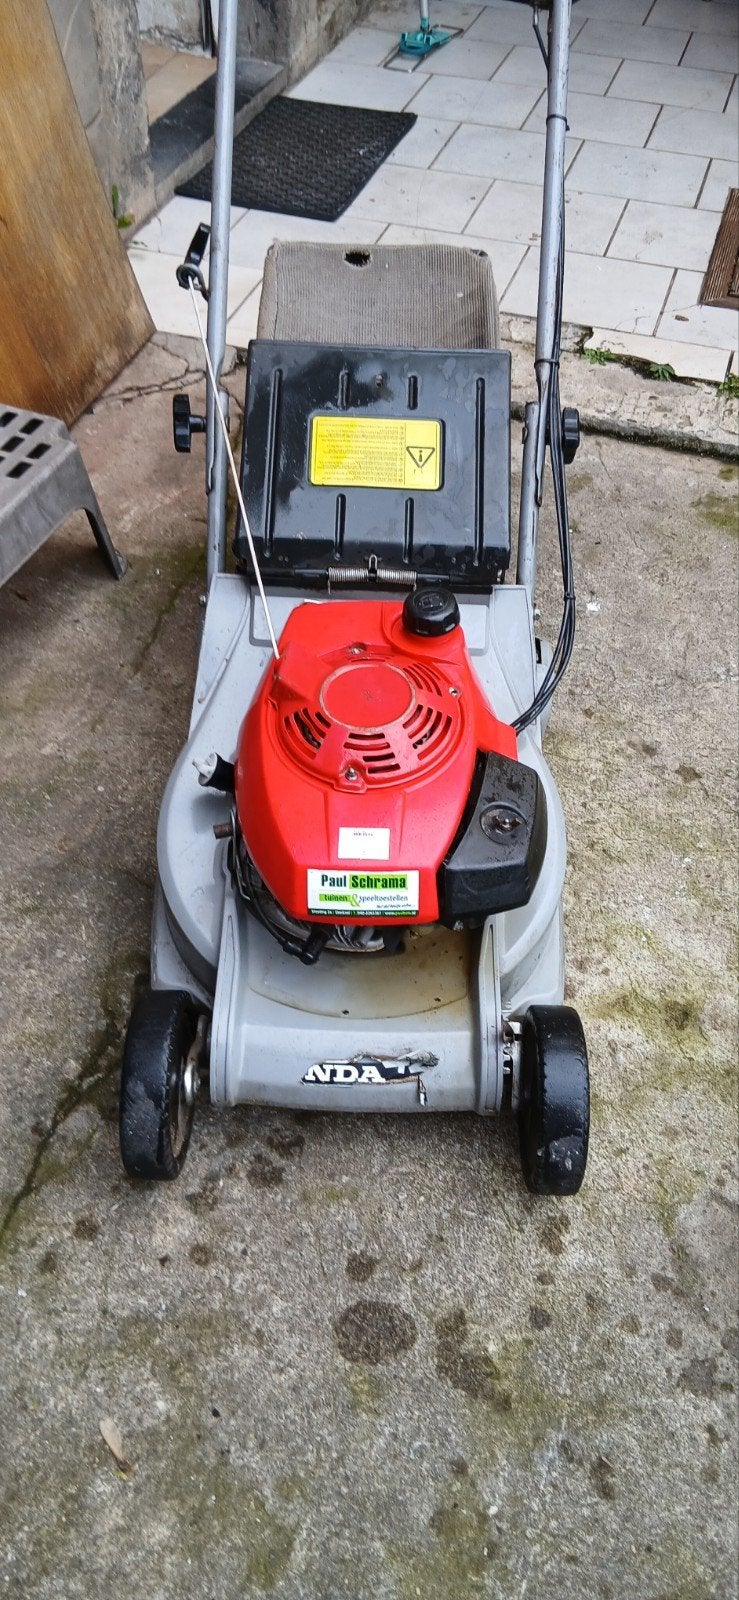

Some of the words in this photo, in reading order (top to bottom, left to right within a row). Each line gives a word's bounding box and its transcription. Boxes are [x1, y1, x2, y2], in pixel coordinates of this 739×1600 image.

[321, 874, 347, 887] Paul
[351, 875, 406, 889] Schrama
[324, 894, 348, 902] tuinen
[350, 894, 360, 907] &
[358, 894, 408, 903] speeltoestellen
